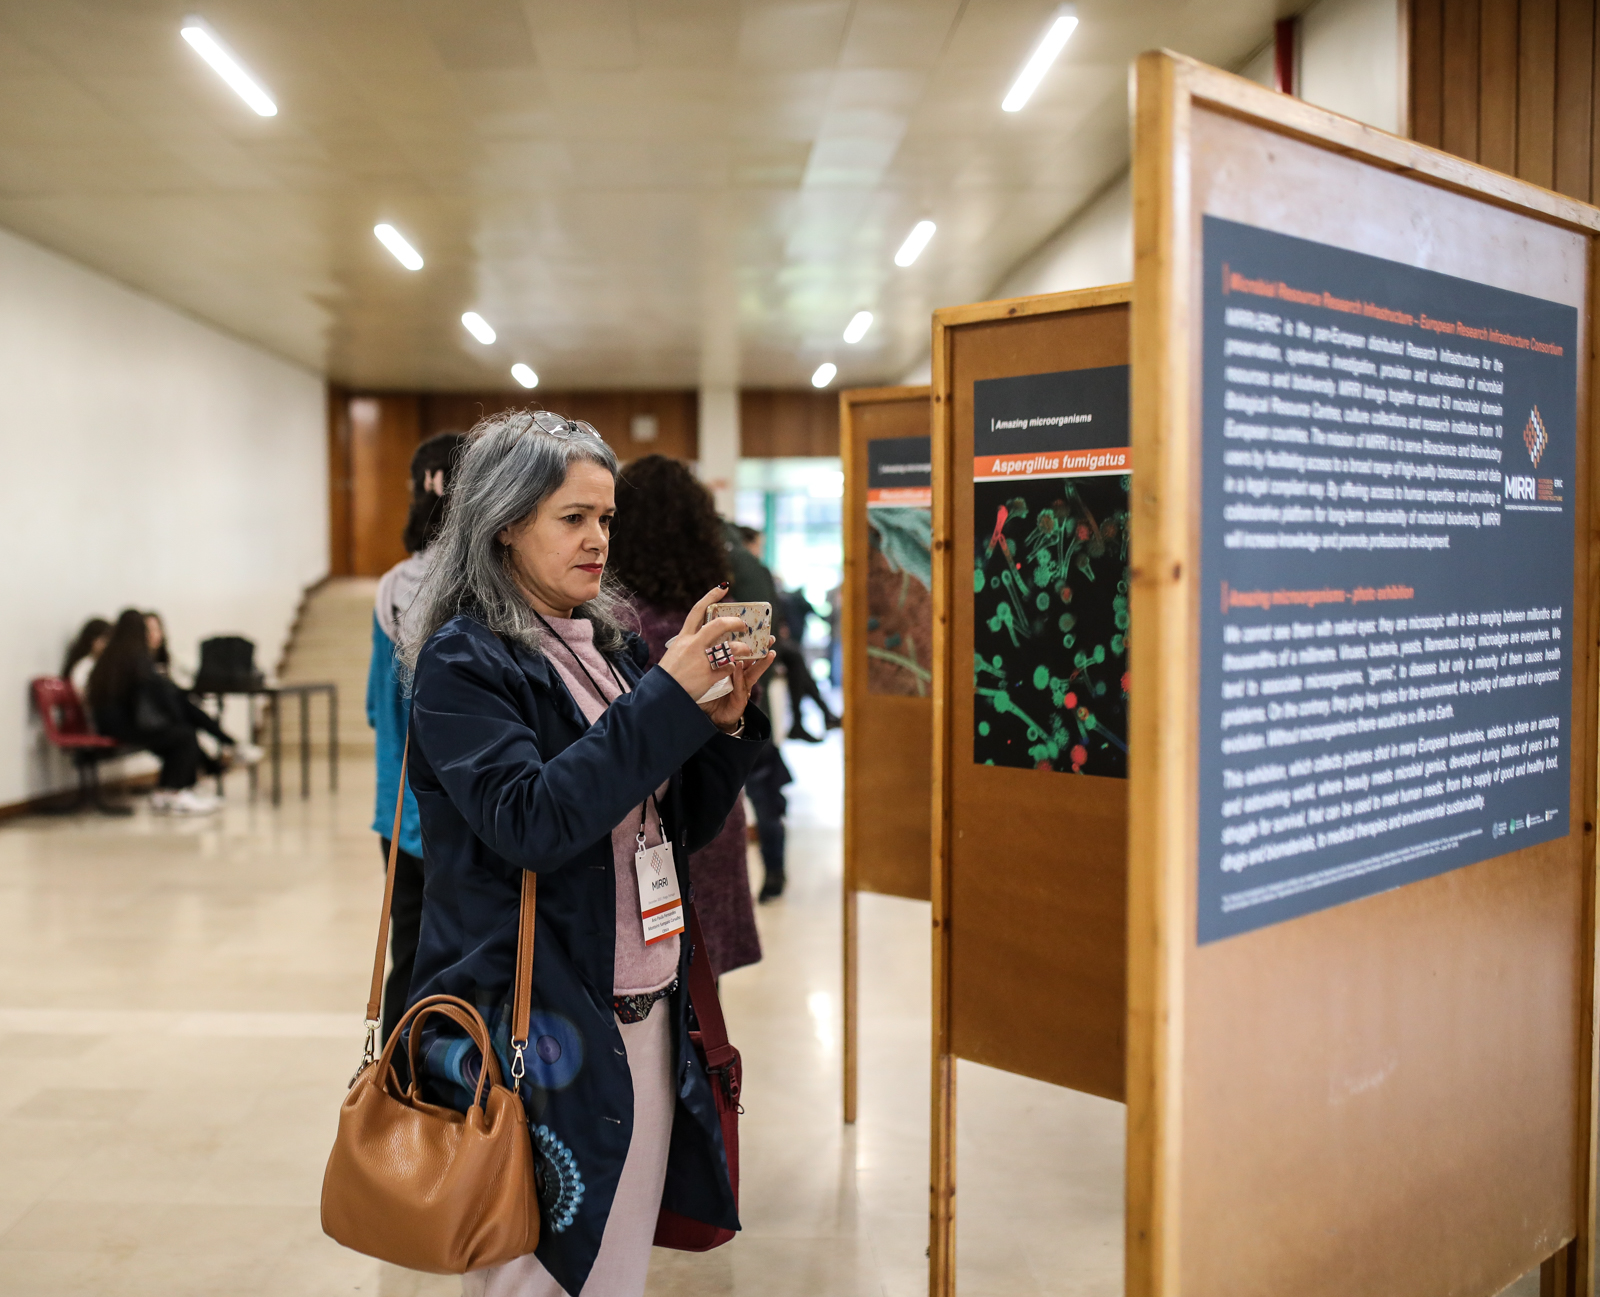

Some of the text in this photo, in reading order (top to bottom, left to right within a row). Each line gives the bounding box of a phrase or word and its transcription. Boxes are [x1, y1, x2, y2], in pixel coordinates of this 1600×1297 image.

[995, 413, 1092, 430] Amazing microorganisms
[992, 453, 1126, 475] Aspergillus fumigatus
[1504, 475, 1536, 500] MIRRI
[652, 877, 668, 891] MIRRI
